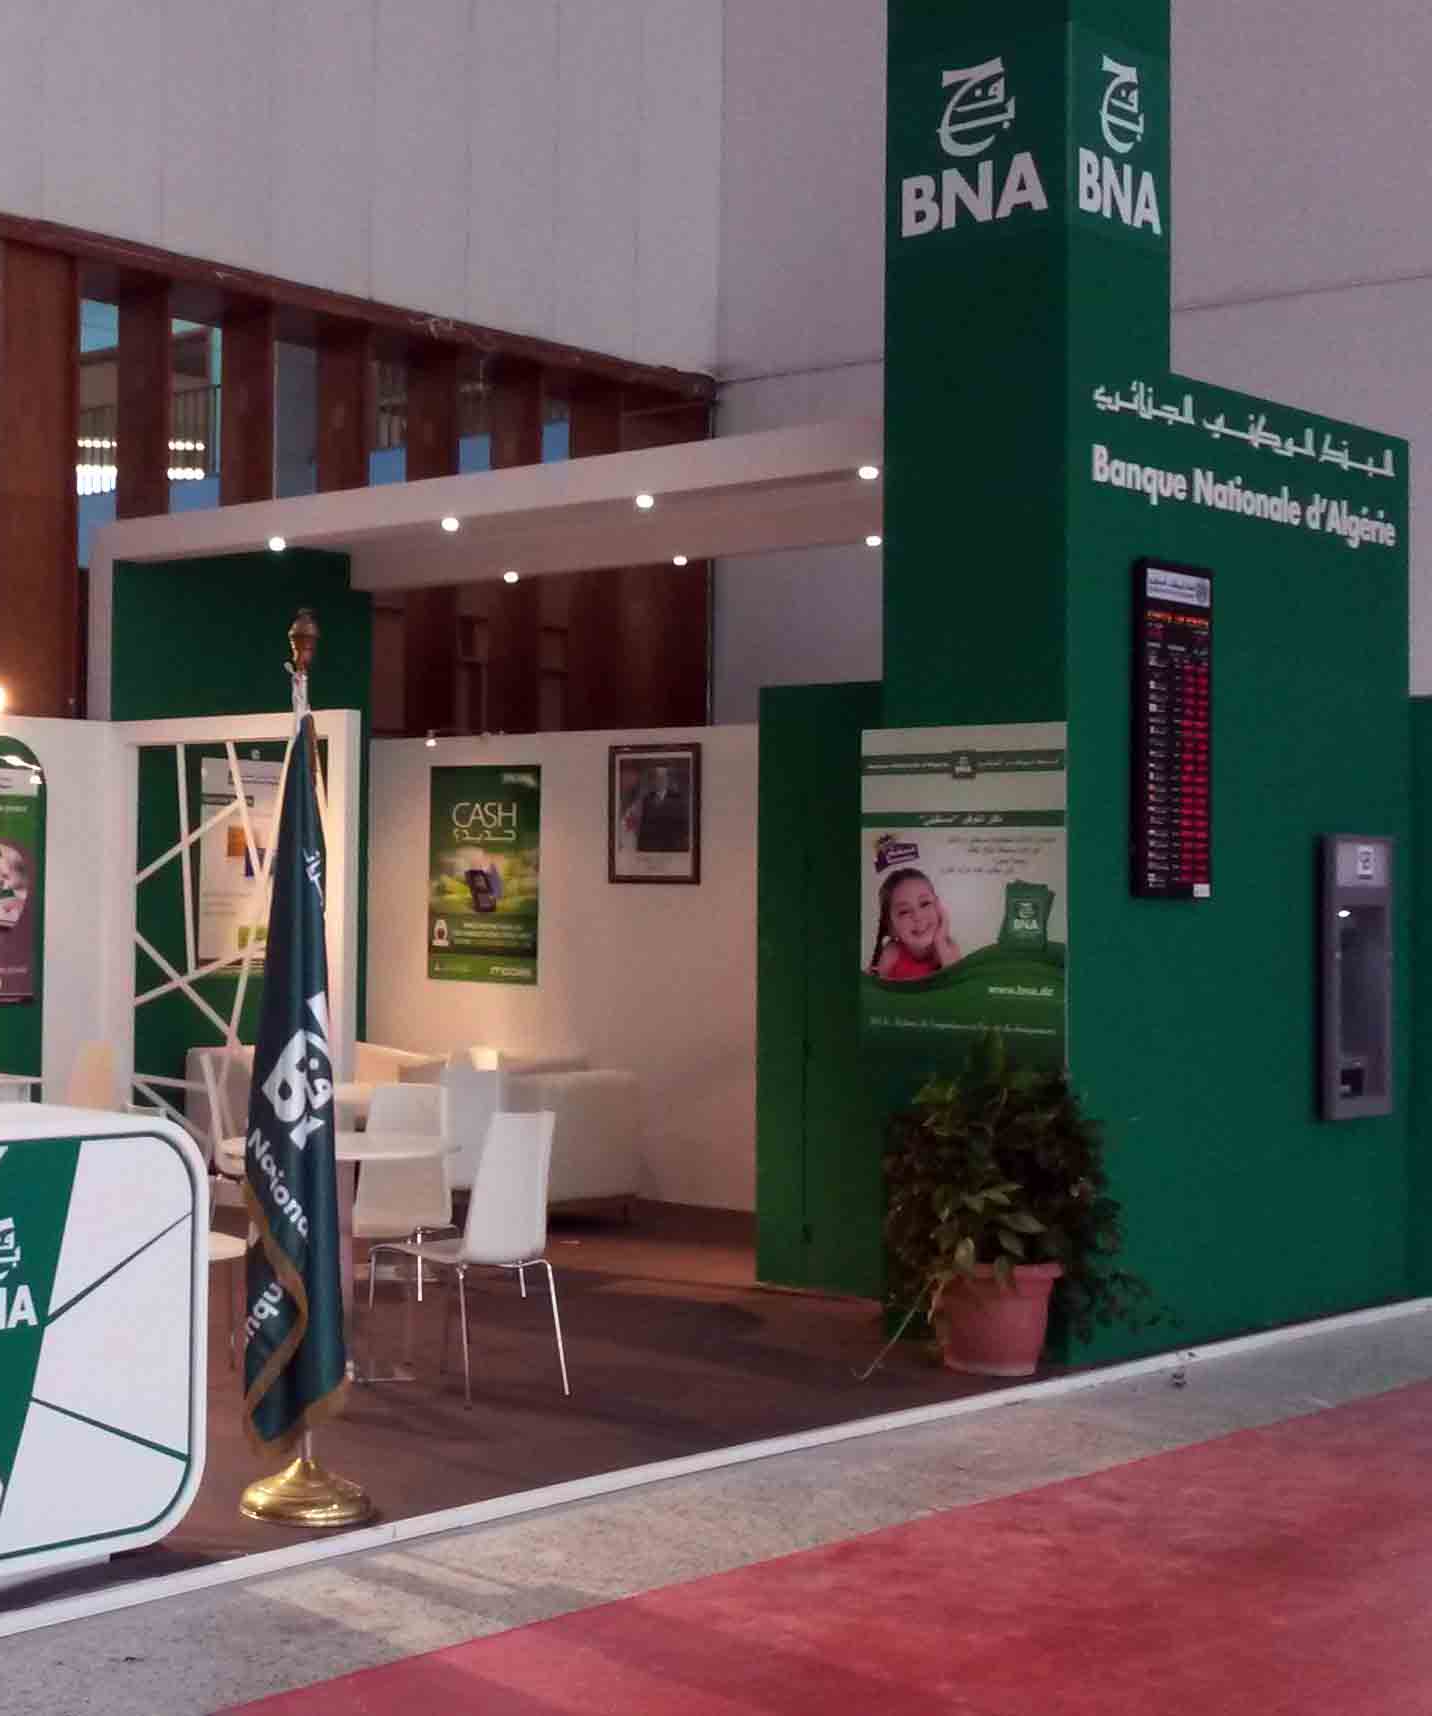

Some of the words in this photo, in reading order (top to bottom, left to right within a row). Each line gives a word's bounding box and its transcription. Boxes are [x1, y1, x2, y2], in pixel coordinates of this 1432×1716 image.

[901, 151, 1049, 238] BNA
[1078, 146, 1162, 236] BNA
[1091, 443, 1187, 507] Banque
[1192, 467, 1301, 527] Nationale
[451, 802, 518, 829] CASH
